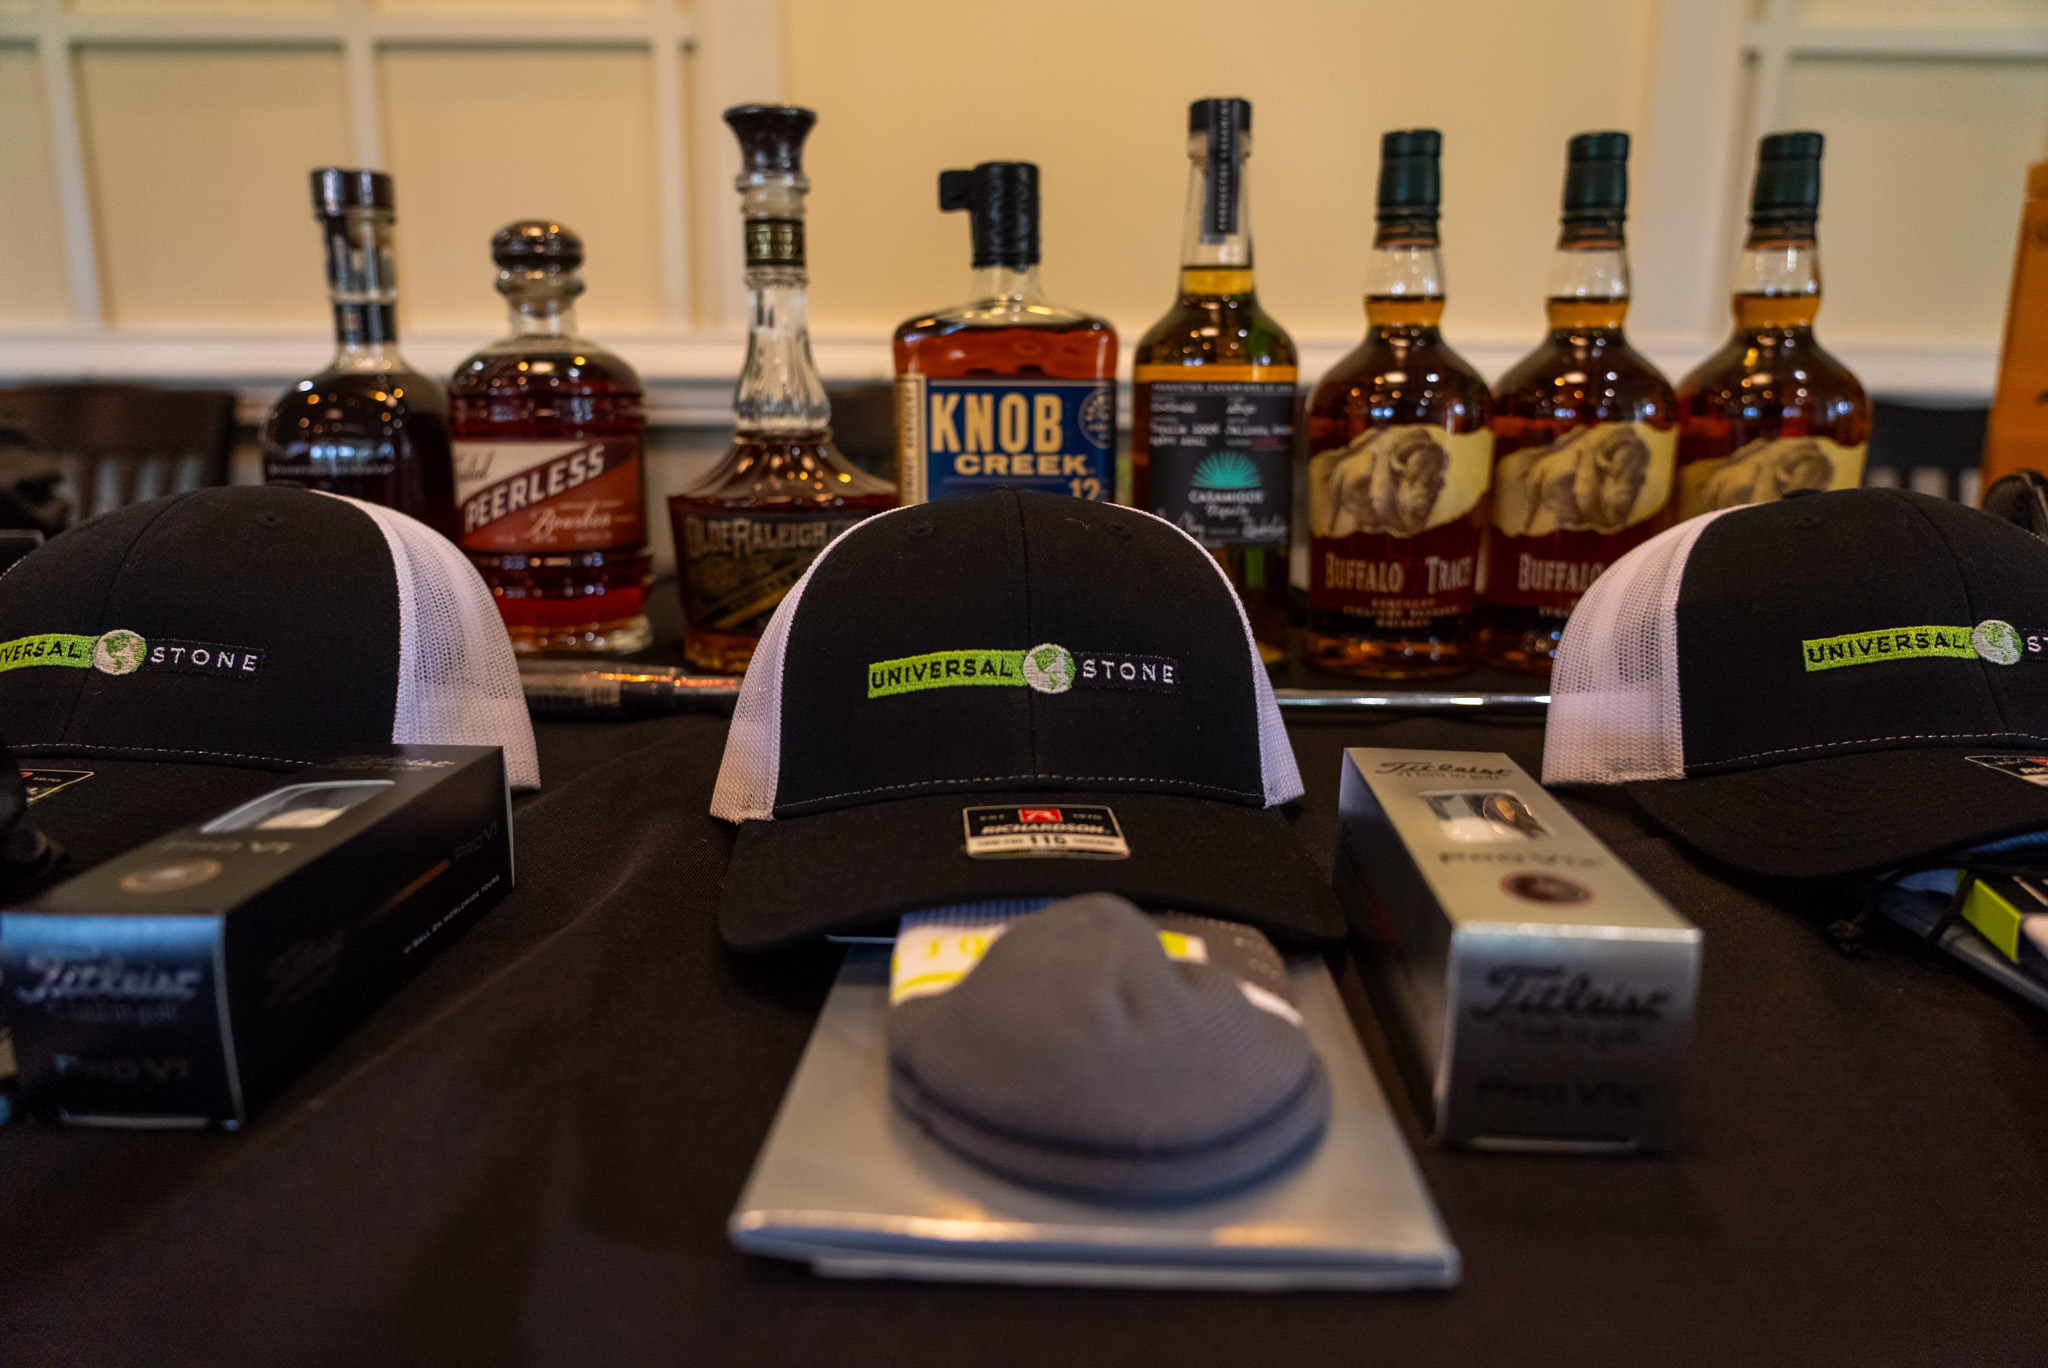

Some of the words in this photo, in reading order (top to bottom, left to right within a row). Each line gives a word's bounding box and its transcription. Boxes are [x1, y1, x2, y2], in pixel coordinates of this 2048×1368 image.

[930, 392, 1064, 454] KNOB
[953, 453, 1087, 476] CREEK
[464, 443, 606, 534] PEERLESS
[1069, 477, 1100, 500] 12
[1325, 551, 1404, 593] BUFFALO
[150, 646, 259, 672] STONE
[1807, 632, 1966, 664] UNIVERSAL
[871, 659, 1013, 690] UNIVERSAL
[1082, 659, 1175, 684] STONE
[979, 823, 1105, 835] RICHARDSON
[1029, 836, 1067, 846] 115
[1471, 965, 1673, 1021] Titleist
